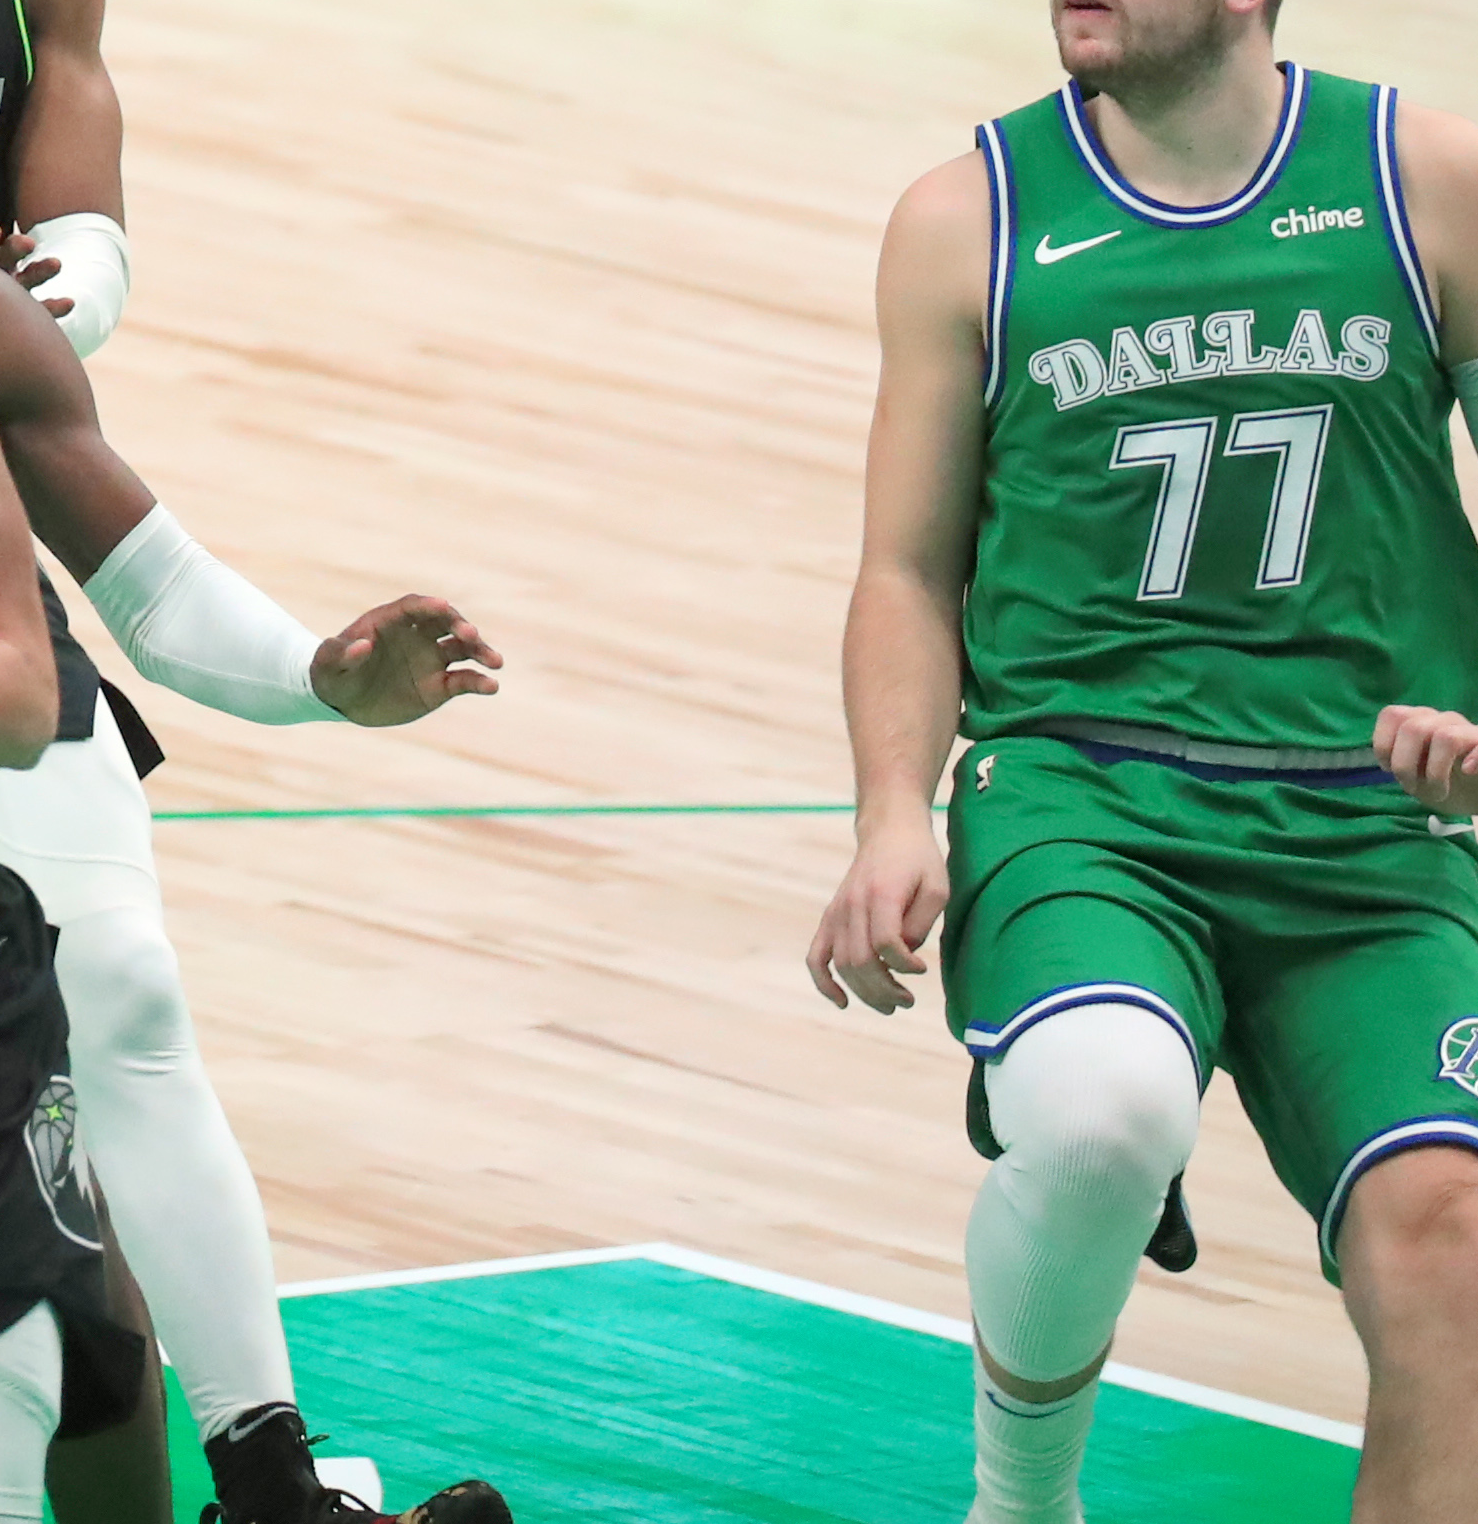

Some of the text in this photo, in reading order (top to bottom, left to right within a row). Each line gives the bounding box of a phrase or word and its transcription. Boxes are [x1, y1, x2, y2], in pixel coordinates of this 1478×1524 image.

[1270, 205, 1365, 239] chime
[1028, 309, 1392, 412] DALLAS
[1108, 403, 1335, 602] 77
